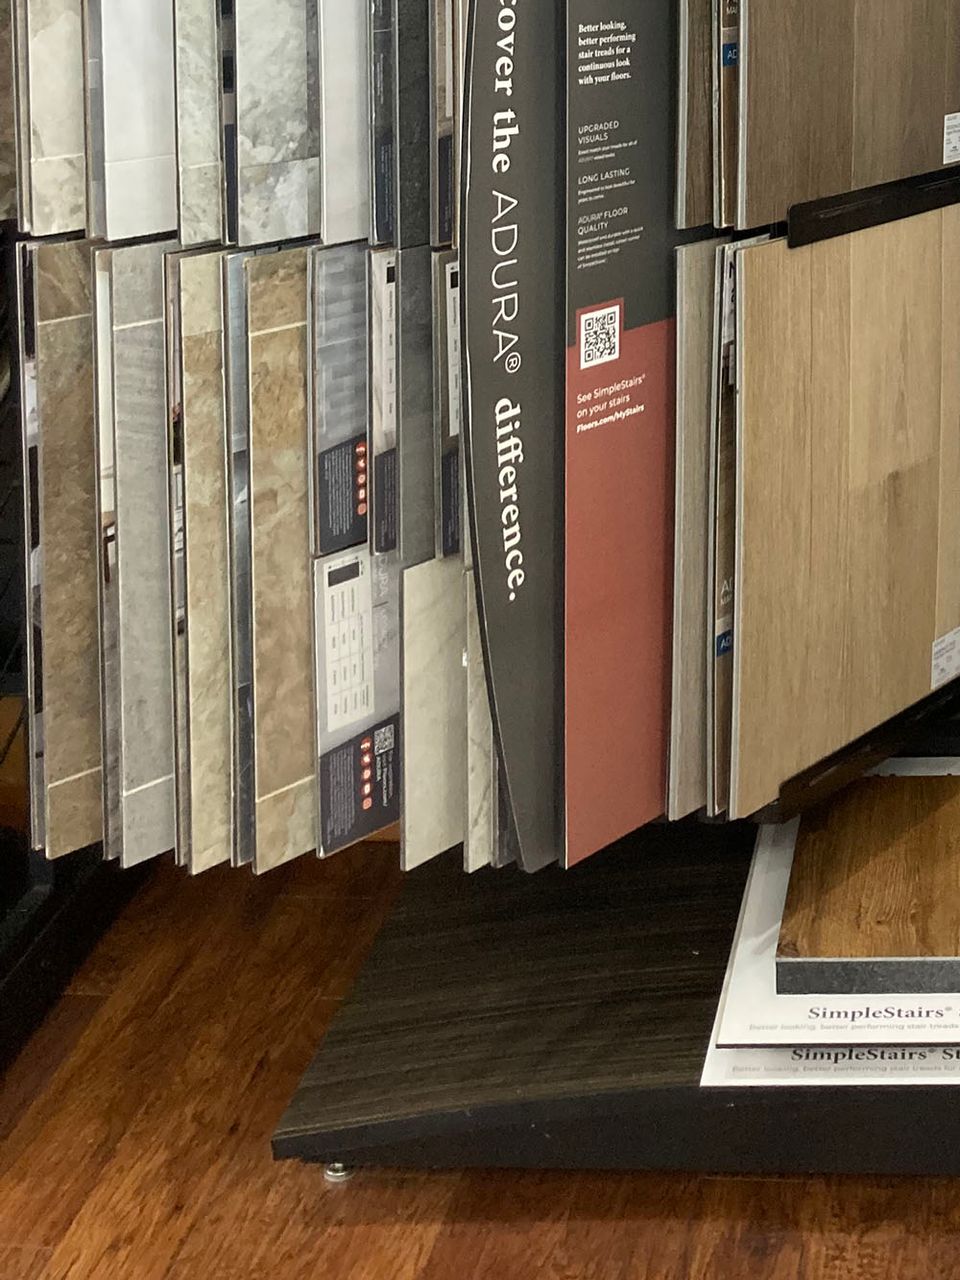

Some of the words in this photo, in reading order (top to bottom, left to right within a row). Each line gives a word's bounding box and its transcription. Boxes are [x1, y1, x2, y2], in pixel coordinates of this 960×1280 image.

[578, 23, 599, 33] Better
[578, 36, 598, 46] better
[599, 32, 636, 46] performing
[578, 49, 593, 59] stair
[594, 46, 615, 57] treads
[615, 45, 625, 55] for
[577, 61, 615, 72] continuous
[615, 57, 630, 67] look
[578, 74, 593, 85] with
[594, 75, 610, 85] your
[578, 120, 619, 134] UPGRADED
[492, 108, 519, 173] the
[578, 132, 608, 145] VISUALS
[577, 173, 599, 185] LONG
[600, 167, 630, 180] LASTING
[603, 206, 629, 219] FLOOR
[577, 222, 609, 236] QUALITY
[577, 392, 592, 404] See
[576, 408, 588, 418] on
[589, 402, 607, 417] your
[608, 394, 630, 408] stairs
[494, 397, 526, 601] difference.
